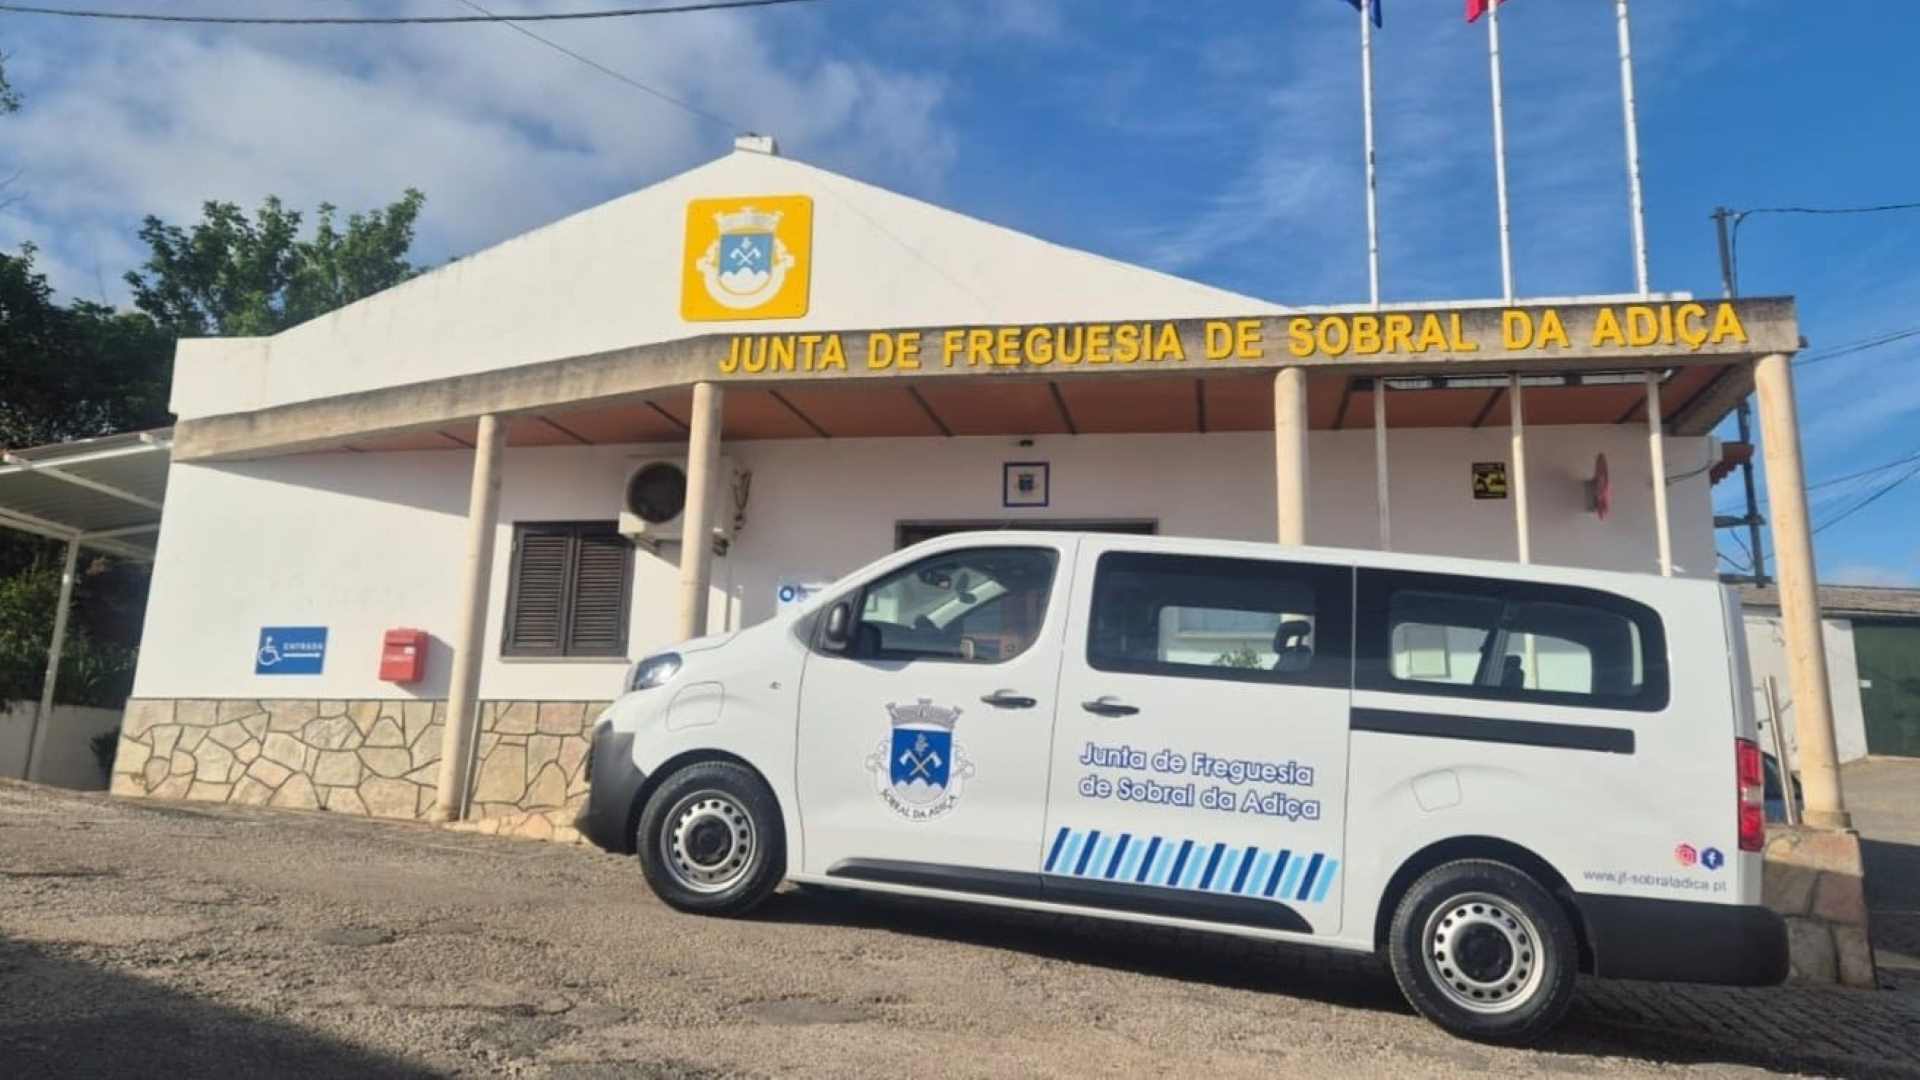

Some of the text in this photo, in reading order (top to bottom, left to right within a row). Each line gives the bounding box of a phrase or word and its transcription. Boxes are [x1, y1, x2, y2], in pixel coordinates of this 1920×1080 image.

[719, 303, 1749, 374] JUNTA DE FREGUESIA DE SOBRAL DA ADIÇA
[1080, 742, 1314, 786] Junta de Freguesia
[913, 809, 926, 819] DA
[1079, 774, 1321, 822] de Sobral da Adiça
